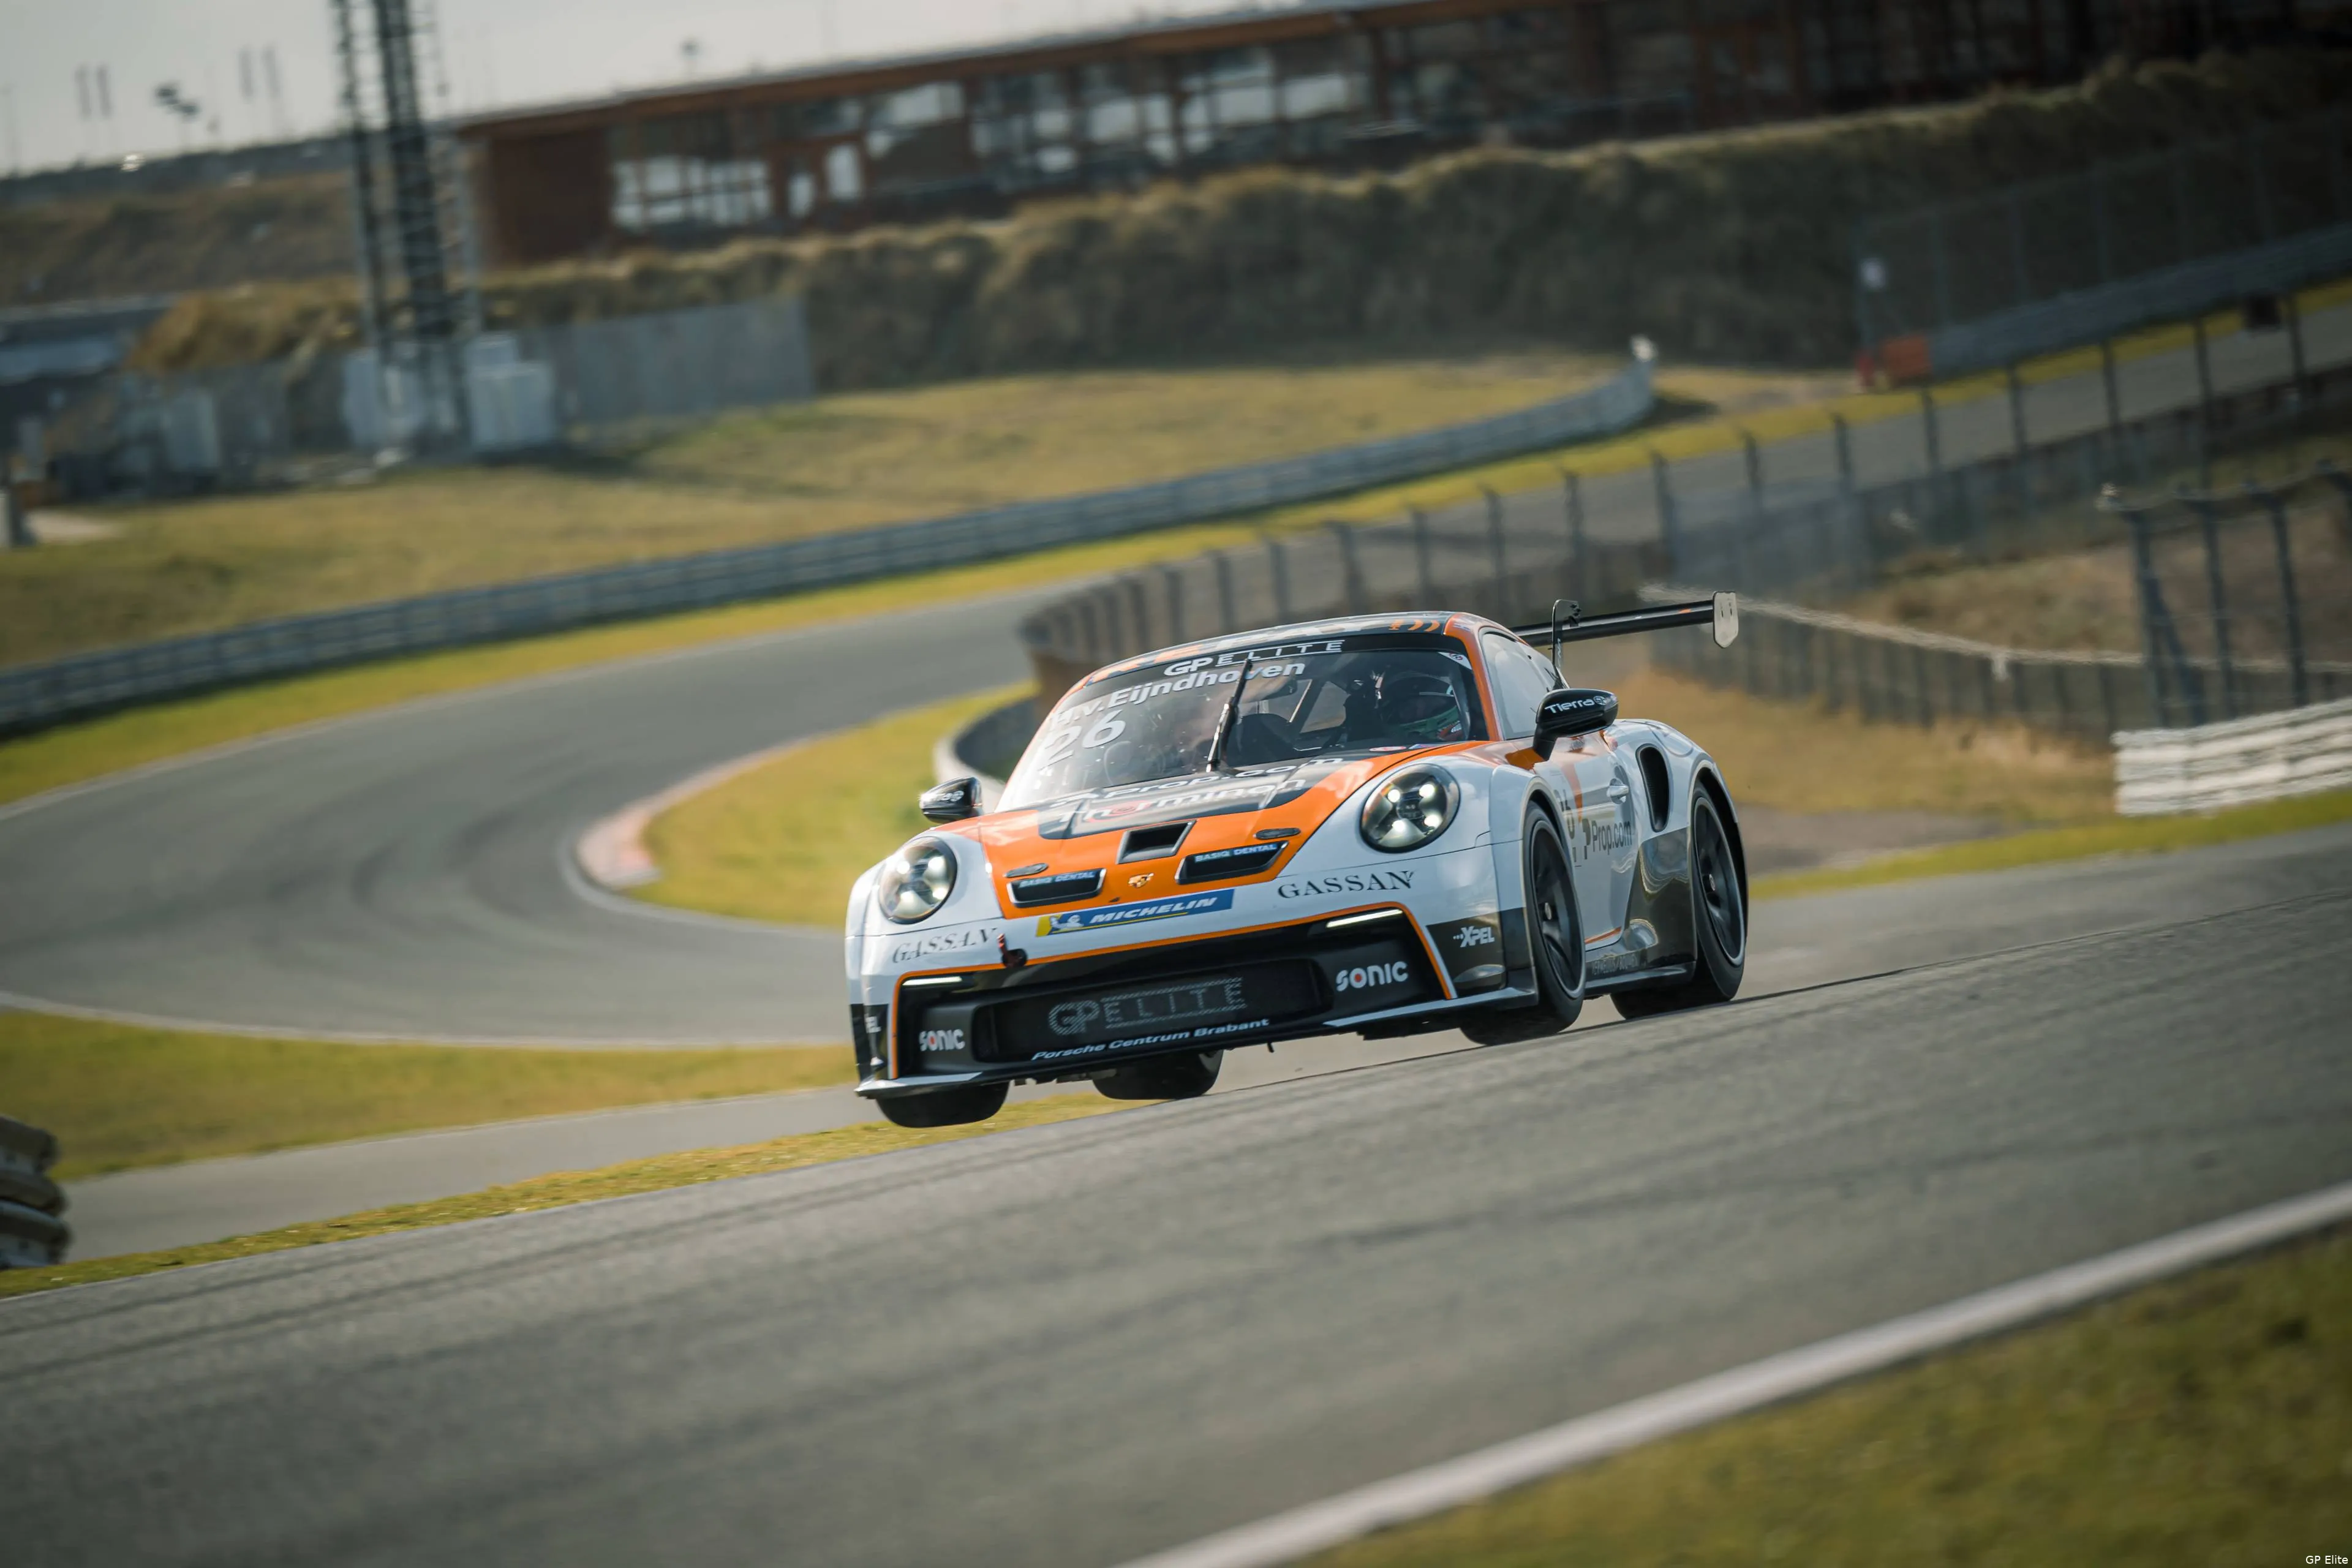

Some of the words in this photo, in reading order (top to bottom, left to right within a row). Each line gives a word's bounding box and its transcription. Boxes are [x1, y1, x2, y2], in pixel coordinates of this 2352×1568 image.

[1164, 657, 1213, 676] GP
[1544, 699, 1595, 714] Tierra
[1038, 709, 1126, 771] 26
[1234, 843, 1278, 856] DENTAL
[1055, 870, 1096, 883] DENTAL
[1278, 870, 1417, 899] GASSAN
[1089, 897, 1218, 924] MICHELIN
[892, 927, 998, 963] GASSAN
[1459, 926, 1495, 948] XPEL
[1031, 1043, 1106, 1061] Porsche
[1108, 1031, 1191, 1050] Centrum
[1194, 1019, 1269, 1037] Brabant
